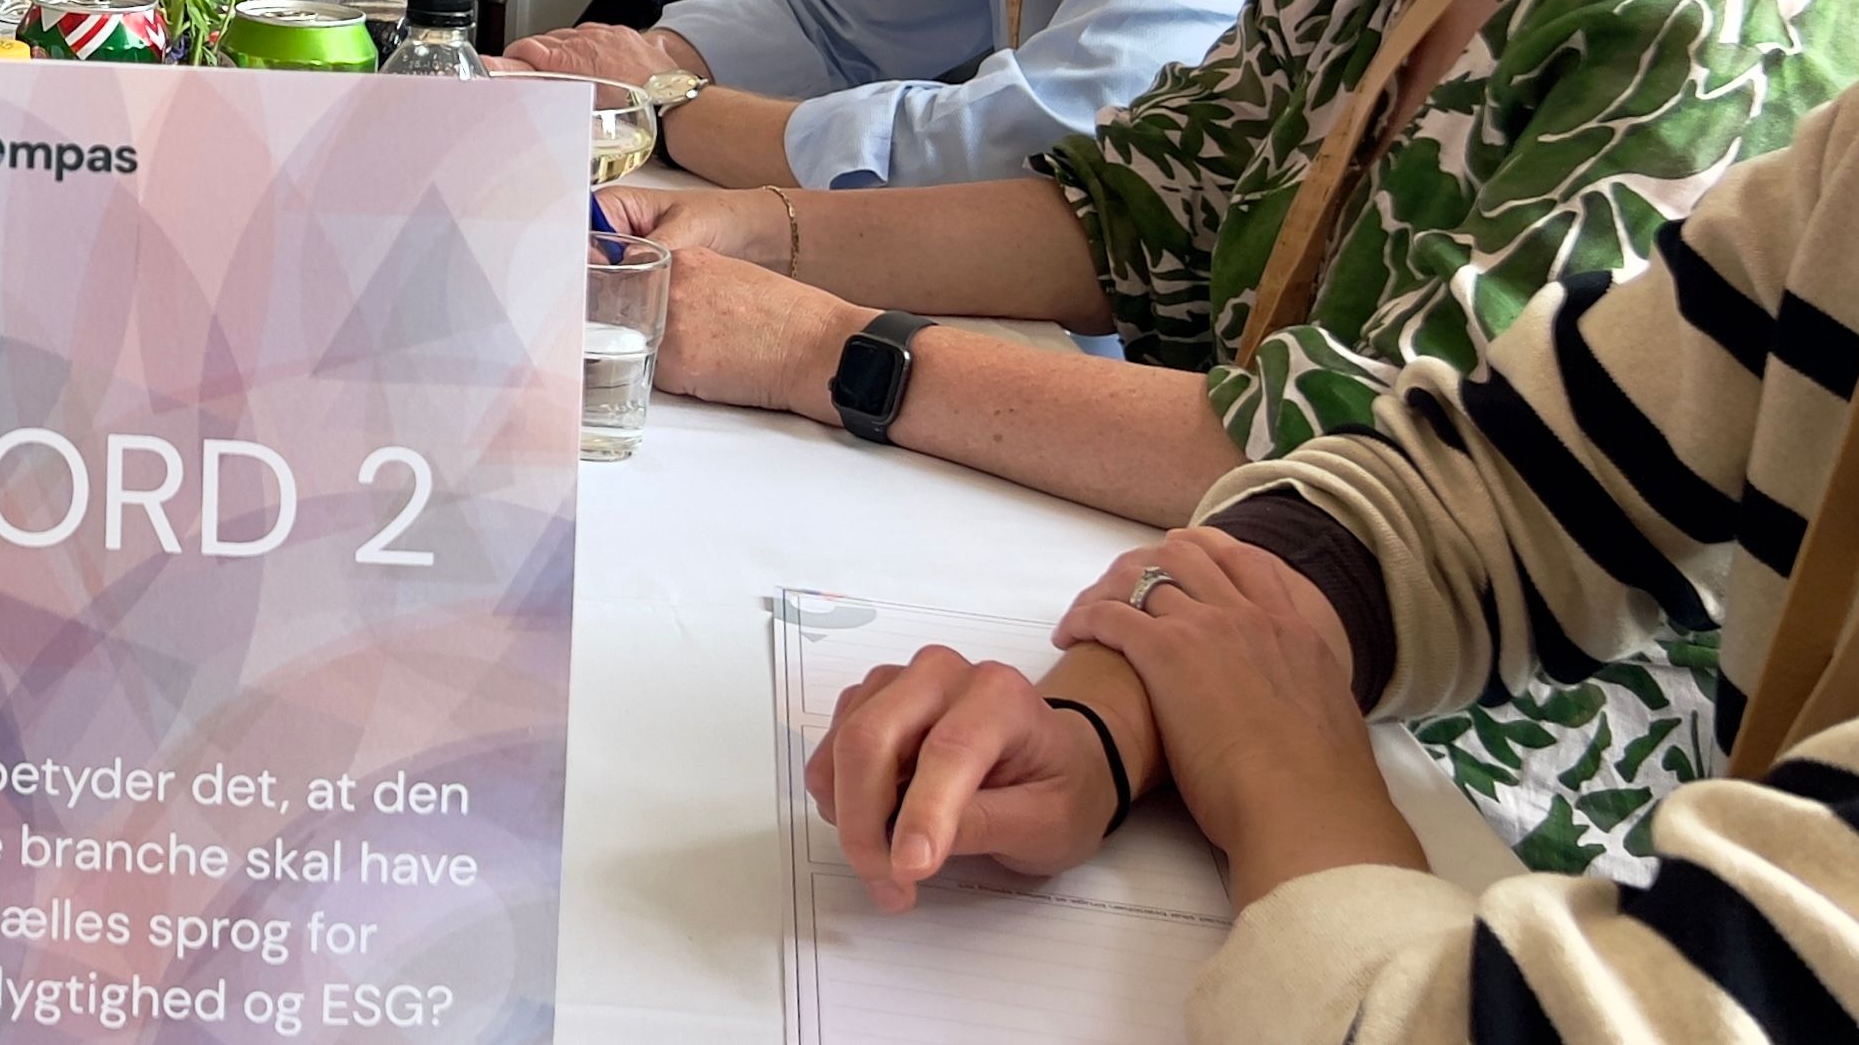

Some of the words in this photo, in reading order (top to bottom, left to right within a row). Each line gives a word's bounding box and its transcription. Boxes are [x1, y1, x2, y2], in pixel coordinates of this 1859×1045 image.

[355, 445, 434, 565] 2
[192, 762, 289, 815] det,
[306, 771, 355, 812] at
[373, 770, 469, 815] den
[21, 824, 229, 878] branche
[245, 838, 343, 883] skal
[360, 842, 478, 886] have
[148, 916, 291, 966] sprog
[308, 911, 378, 955] for
[244, 988, 305, 1036] og
[322, 983, 453, 1028] ESG?
